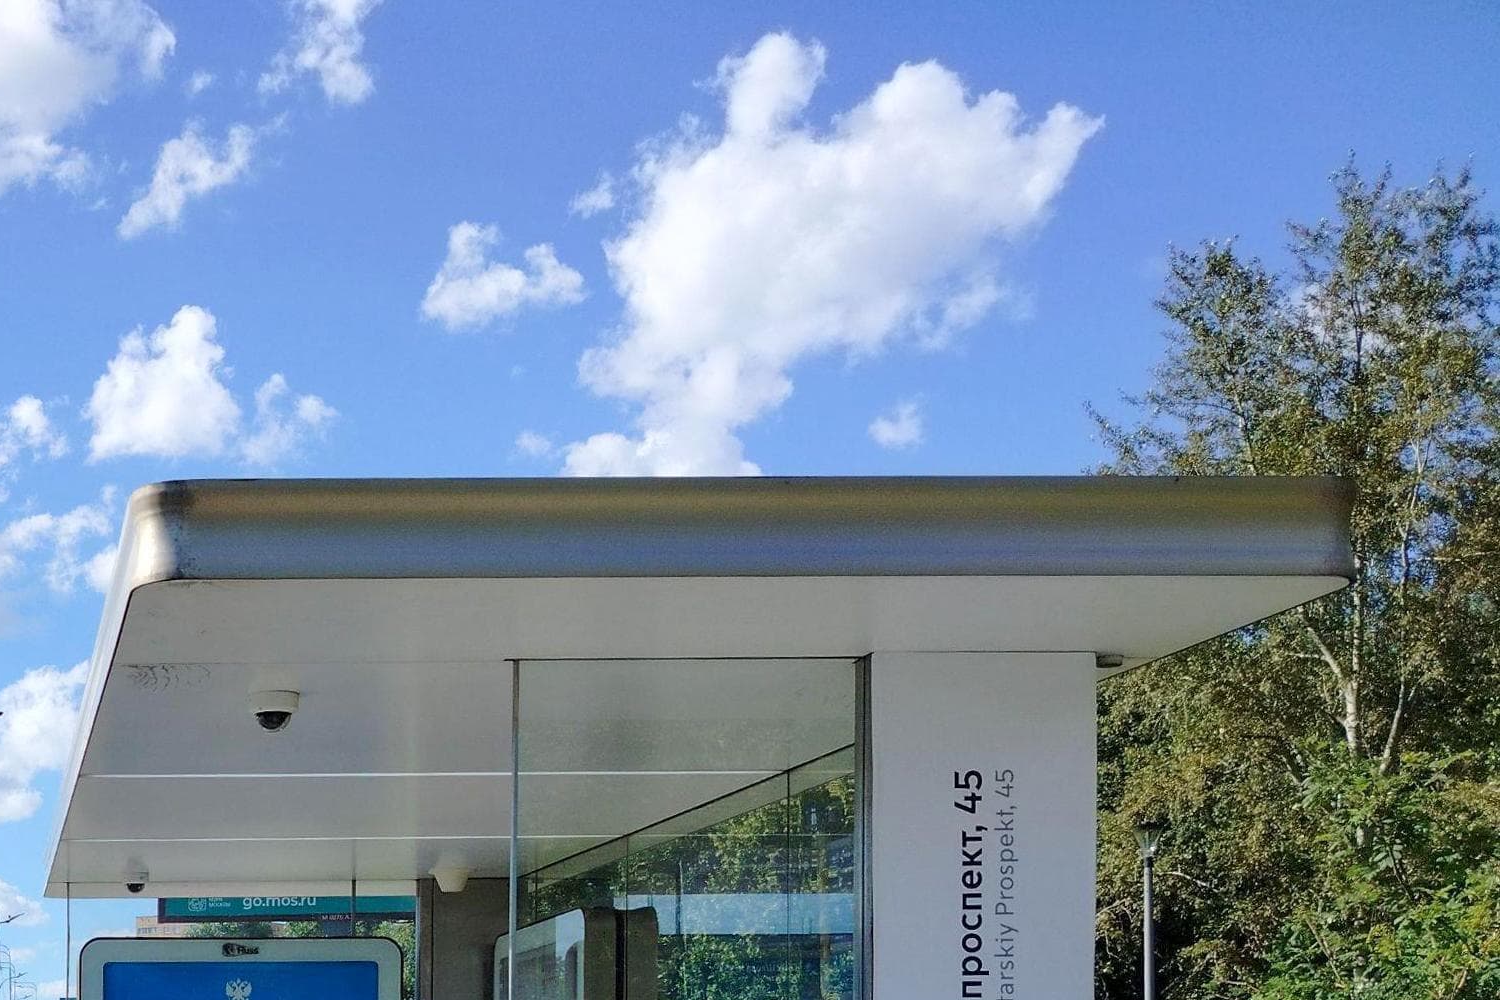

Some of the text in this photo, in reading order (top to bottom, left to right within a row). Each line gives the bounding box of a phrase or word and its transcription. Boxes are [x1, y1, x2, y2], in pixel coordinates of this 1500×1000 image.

[953, 769, 983, 814] 45
[995, 769, 1015, 798] 45
[993, 805, 1019, 916] Prospekt,
[242, 896, 317, 911] go.mos.ru
[961, 825, 990, 998] проспект,
